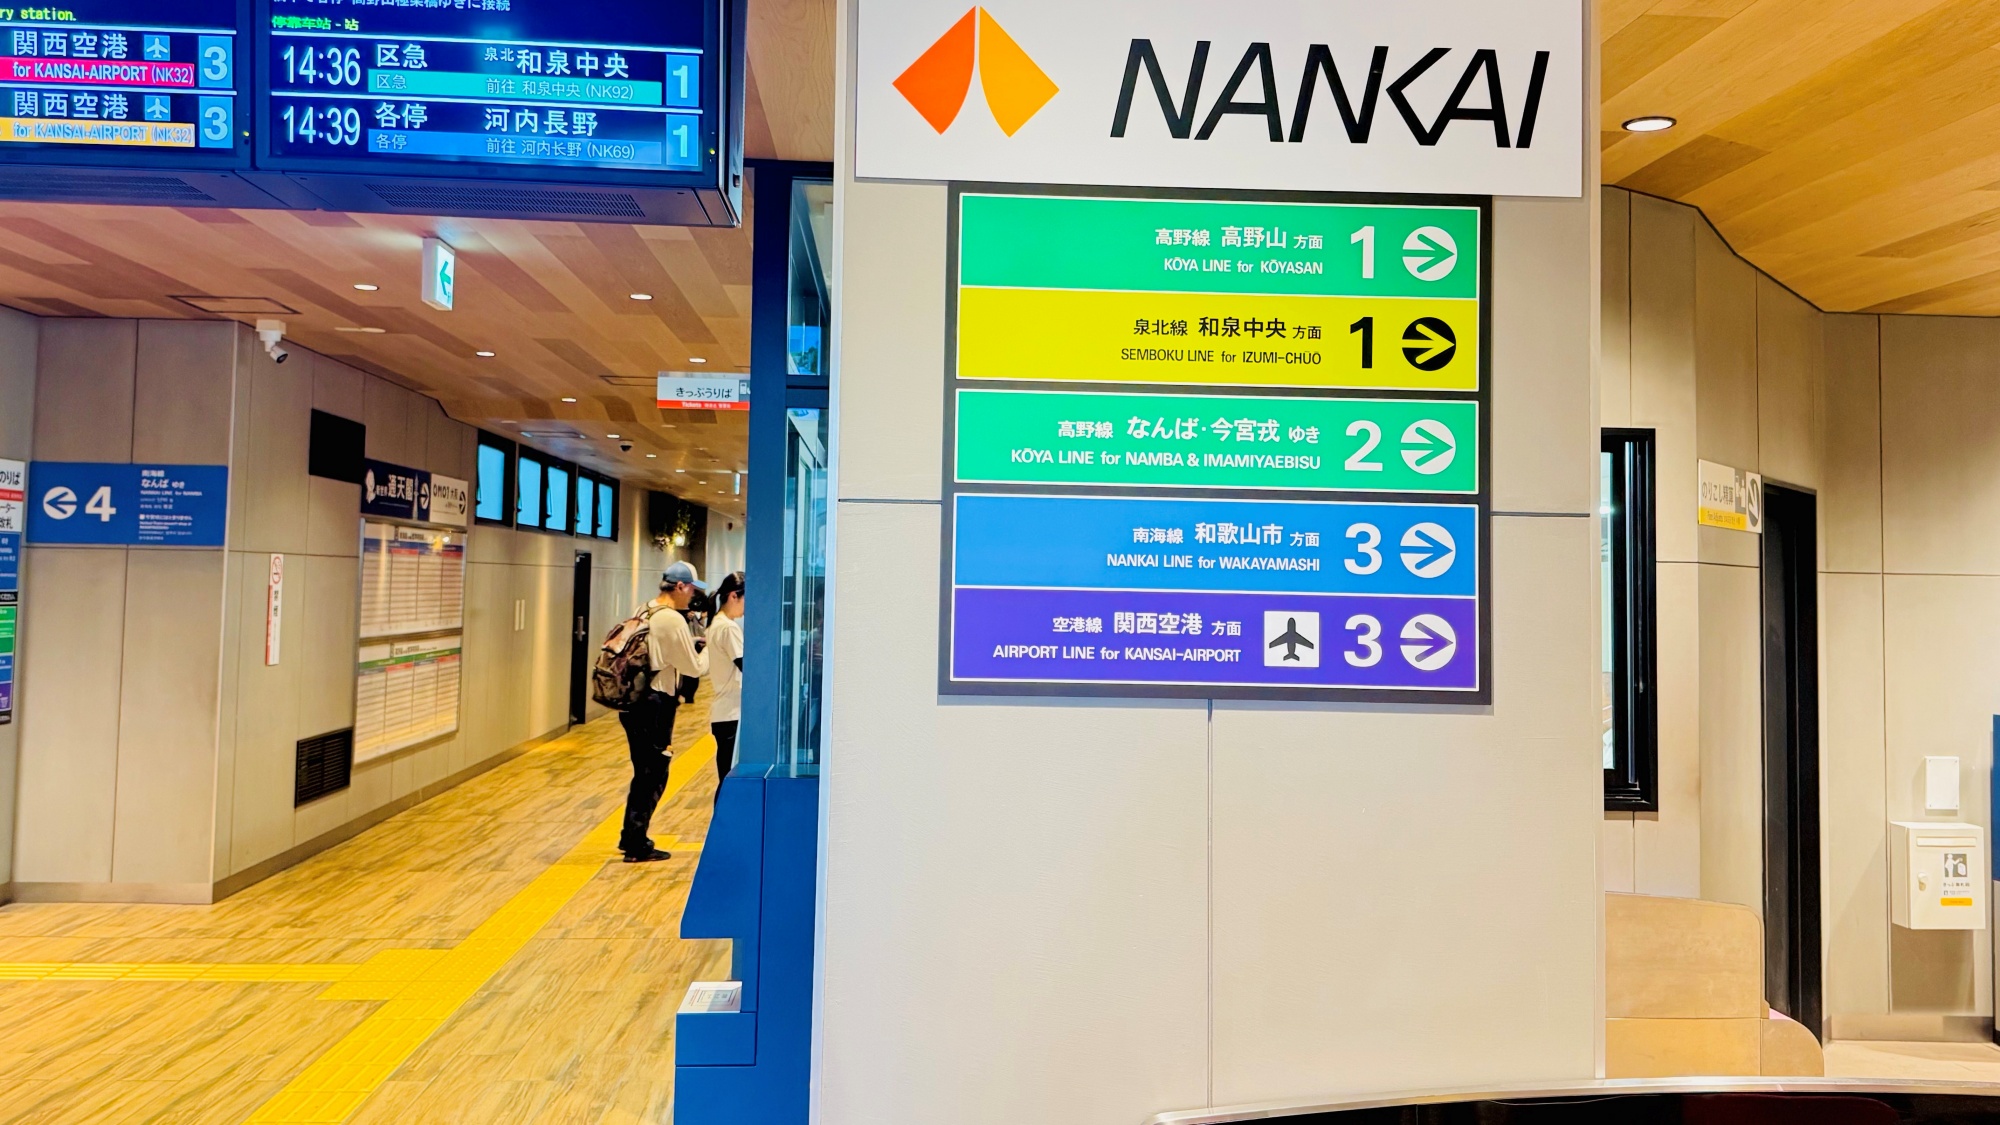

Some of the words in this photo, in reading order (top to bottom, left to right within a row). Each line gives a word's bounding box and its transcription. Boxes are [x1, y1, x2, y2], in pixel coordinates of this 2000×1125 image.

[21, 7, 77, 21] station.
[13, 30, 128, 59] 関西空港
[13, 61, 31, 78] for
[34, 62, 148, 82] KANSAI-AIRPORT
[151, 66, 194, 84] (NK32)
[203, 46, 228, 81] 3
[283, 46, 361, 86] 14:36
[376, 44, 428, 69] 区急
[484, 47, 514, 62] 泉北
[516, 49, 629, 79] 和泉中央
[376, 74, 407, 90] 区急
[486, 78, 516, 95] 前往
[522, 80, 581, 98] 和泉中央
[585, 83, 634, 101] (NK92)
[672, 65, 688, 99] 1
[1110, 38, 1550, 148] NANKAI
[14, 91, 129, 119] 関西空港
[13, 123, 32, 138] for
[35, 124, 148, 142] KANSAI-AIRPORT
[151, 127, 195, 143] (NK32)
[204, 106, 228, 141] 3
[283, 105, 361, 146] 14:39
[375, 102, 428, 129] 各停
[484, 107, 598, 137] 河内長野
[375, 133, 407, 150] 各停
[485, 138, 516, 155] 前往
[521, 139, 582, 158] 河内长野
[587, 142, 635, 160] (NK69)
[672, 125, 688, 158] 1
[1154, 228, 1211, 247] 高野線
[1221, 226, 1287, 249] 高野山
[1293, 234, 1323, 250] 方面
[1164, 256, 1198, 272] KŌYA
[1202, 259, 1231, 272] LINE
[1237, 260, 1254, 273] for
[1260, 258, 1323, 275] KŌYASAN
[1350, 225, 1375, 279] 1
[1133, 318, 1188, 336] 泉北線
[1198, 316, 1287, 339] 和泉中央
[1292, 325, 1322, 340] 方面
[1349, 316, 1373, 369] 1
[1121, 348, 1183, 361] SEMBOKU
[1187, 350, 1214, 362] LINE
[1221, 351, 1236, 363] for
[1242, 350, 1322, 365] IZUMI-CHŪŌ
[676, 387, 732, 399] きっぷうりば
[1057, 420, 1113, 439] 高野線
[1288, 425, 1320, 444] ゆき
[1344, 420, 1383, 471] 2
[1011, 447, 1054, 463] KŌYA
[1058, 450, 1094, 465] LINE
[1101, 451, 1121, 465] for
[1125, 451, 1184, 467] NAMBA
[1187, 453, 1200, 467] &
[1203, 453, 1321, 470] IMAMIYAEBISU
[0, 471, 21, 485] のりば
[388, 474, 413, 501] 通天閣
[85, 486, 116, 522] 4
[1132, 527, 1184, 544] 南海線
[1194, 522, 1284, 546] 和歌山市
[1289, 531, 1320, 547] 方面
[1344, 522, 1382, 575] 3
[1106, 553, 1159, 568] NANKAI
[1163, 554, 1193, 568] LINE
[1198, 555, 1216, 569] for
[1219, 556, 1320, 572] WAKAYAMASHI
[1052, 616, 1103, 634] 空港線
[1113, 611, 1203, 635] 関西空港
[1211, 620, 1242, 636] 方面
[992, 644, 1059, 660] AIRPORT
[1062, 646, 1096, 660] LINE
[1100, 646, 1120, 660] for
[1124, 647, 1242, 663] KANSAI-AIRPORT
[1344, 614, 1383, 668] 3
